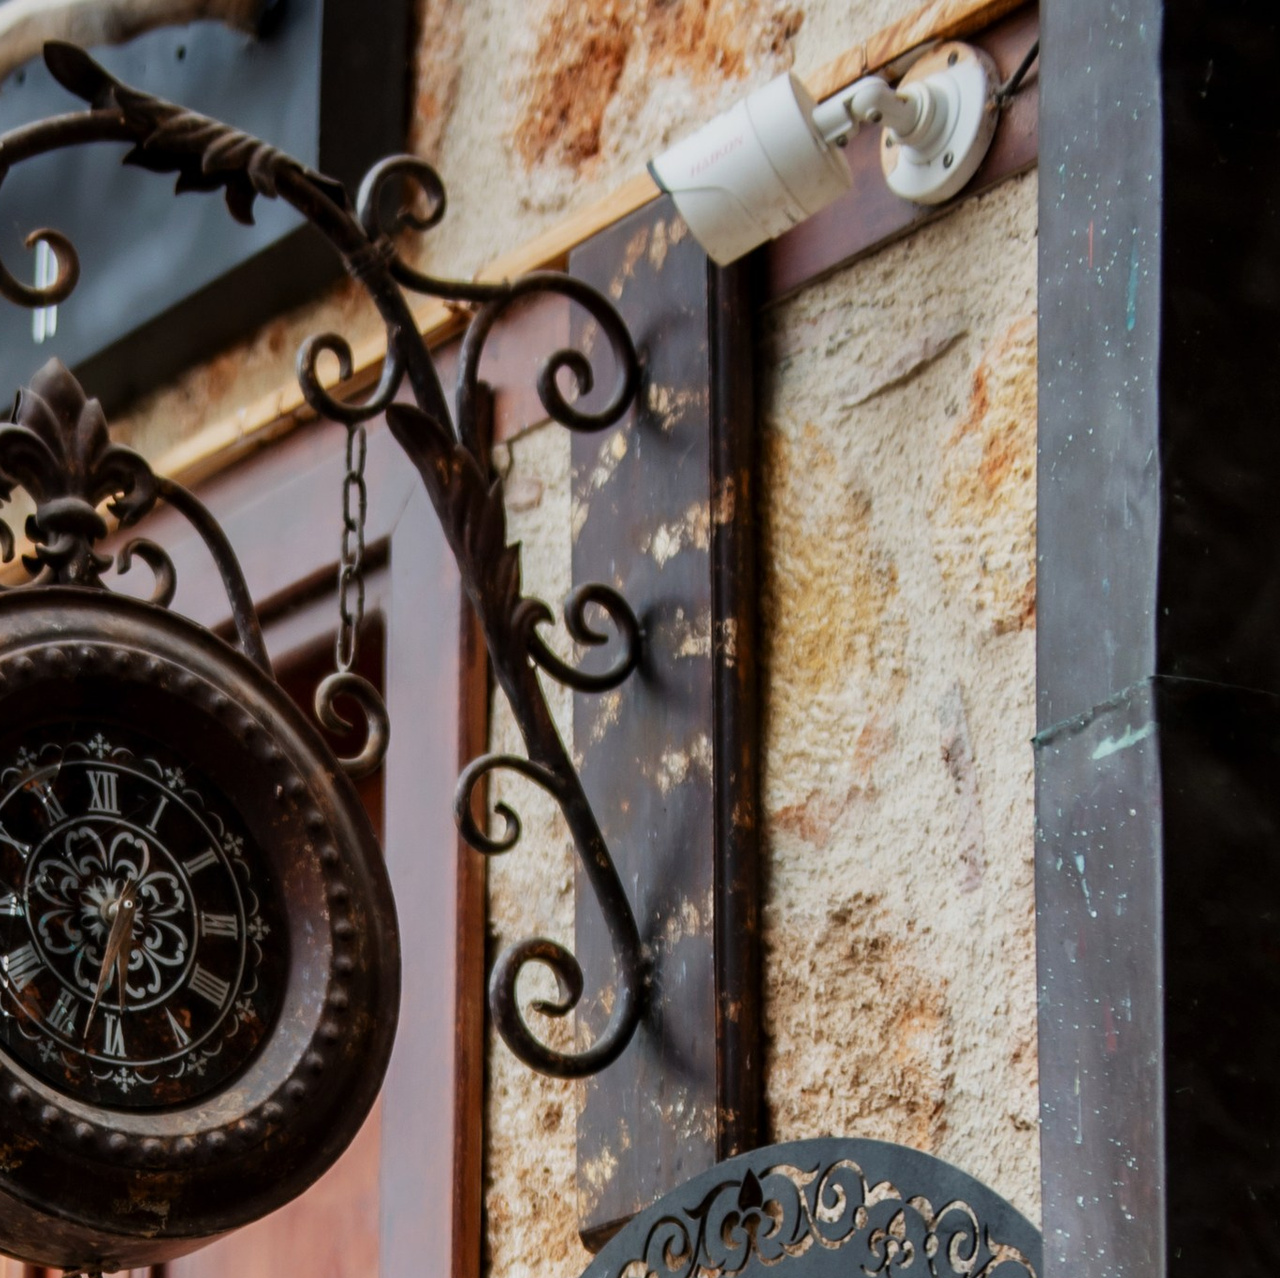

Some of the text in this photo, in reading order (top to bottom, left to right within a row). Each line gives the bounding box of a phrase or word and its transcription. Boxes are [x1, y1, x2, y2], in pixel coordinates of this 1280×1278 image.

[86, 770, 119, 815] XII
[146, 795, 169, 834] I
[182, 847, 219, 877] II
